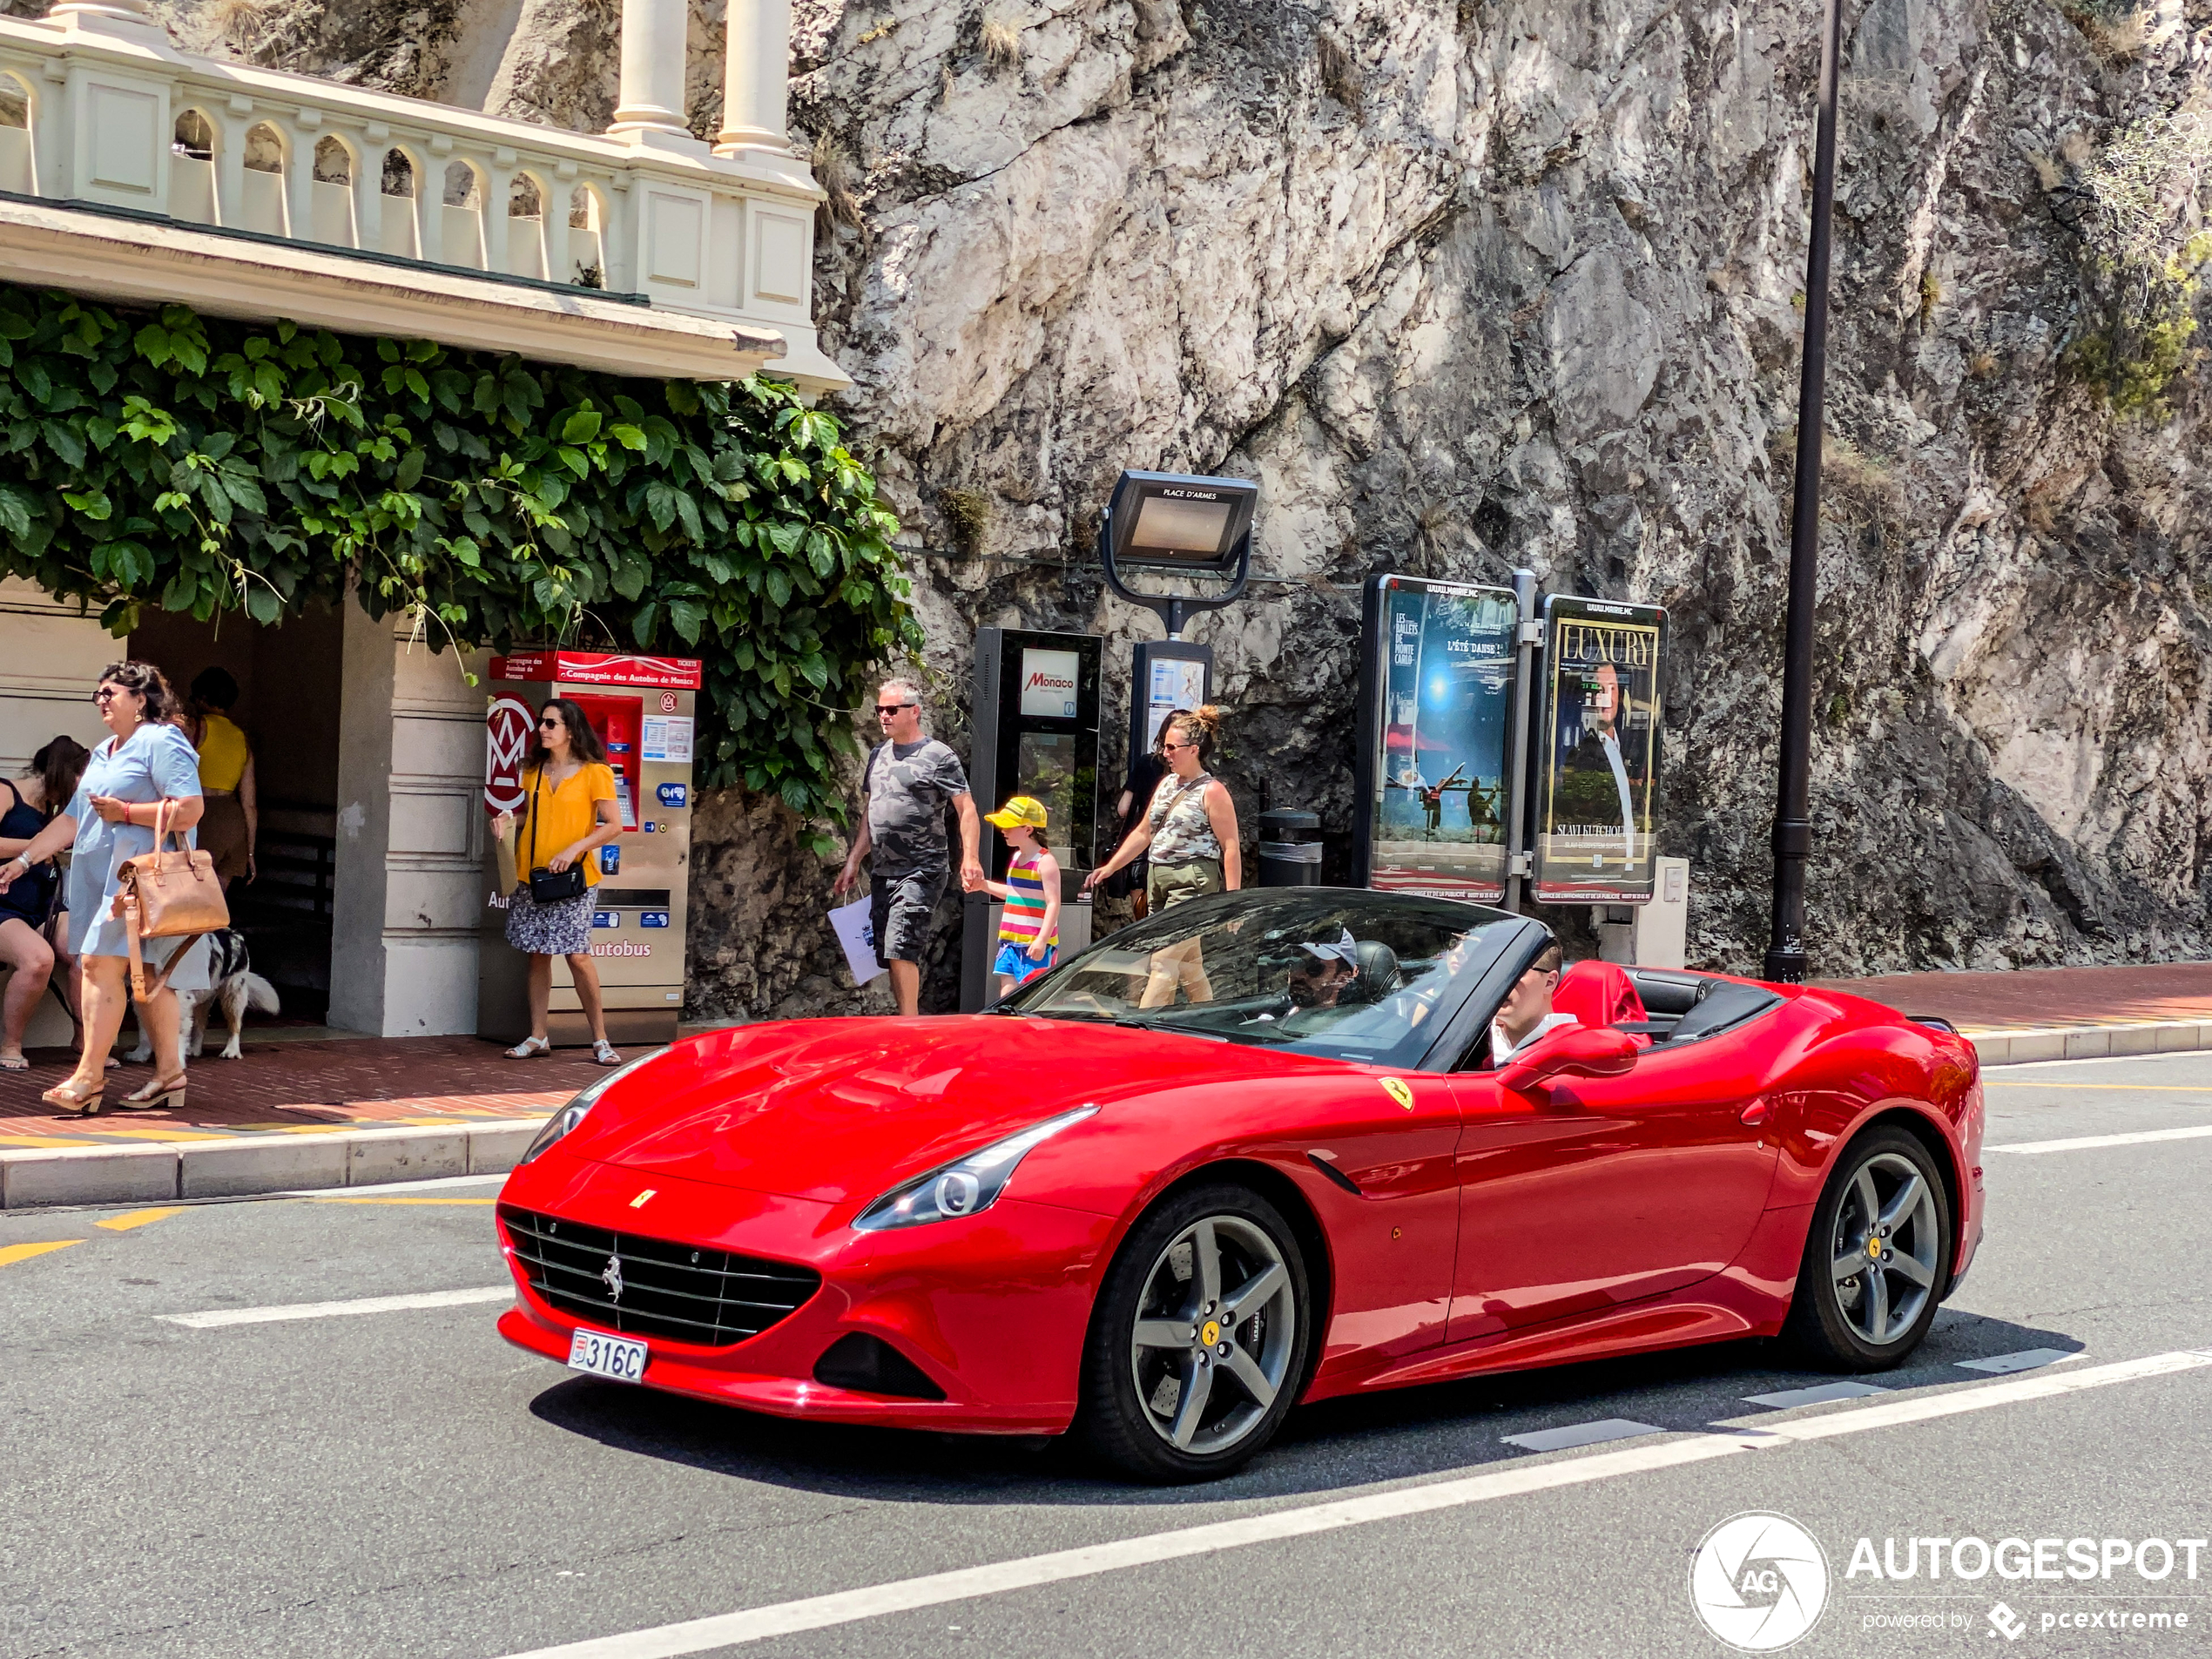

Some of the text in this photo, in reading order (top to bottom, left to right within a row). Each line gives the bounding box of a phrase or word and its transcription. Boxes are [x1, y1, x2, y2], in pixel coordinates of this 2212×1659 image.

[1186, 491, 1217, 500] D'ARMES
[1426, 584, 1479, 597] WWW.MAIRIE.MC
[1587, 604, 1633, 615] WWW.MAIRIE.MC
[1396, 613, 1406, 623] LES
[1395, 624, 1418, 635] BALLETS
[1395, 634, 1403, 644] DE
[1395, 644, 1414, 655] MONTE
[1447, 638, 1469, 651] L'ÉTÉ
[1471, 643, 1495, 654] DANSE
[1562, 625, 1654, 665] LUXURY
[1395, 654, 1413, 664] CARLO
[566, 670, 611, 682] Compagnie
[629, 674, 658, 683] Autobus
[671, 677, 694, 685] Monaco
[1024, 672, 1074, 691] Monaco
[1557, 824, 1581, 836] SLAVI
[586, 1339, 641, 1379] 316C
